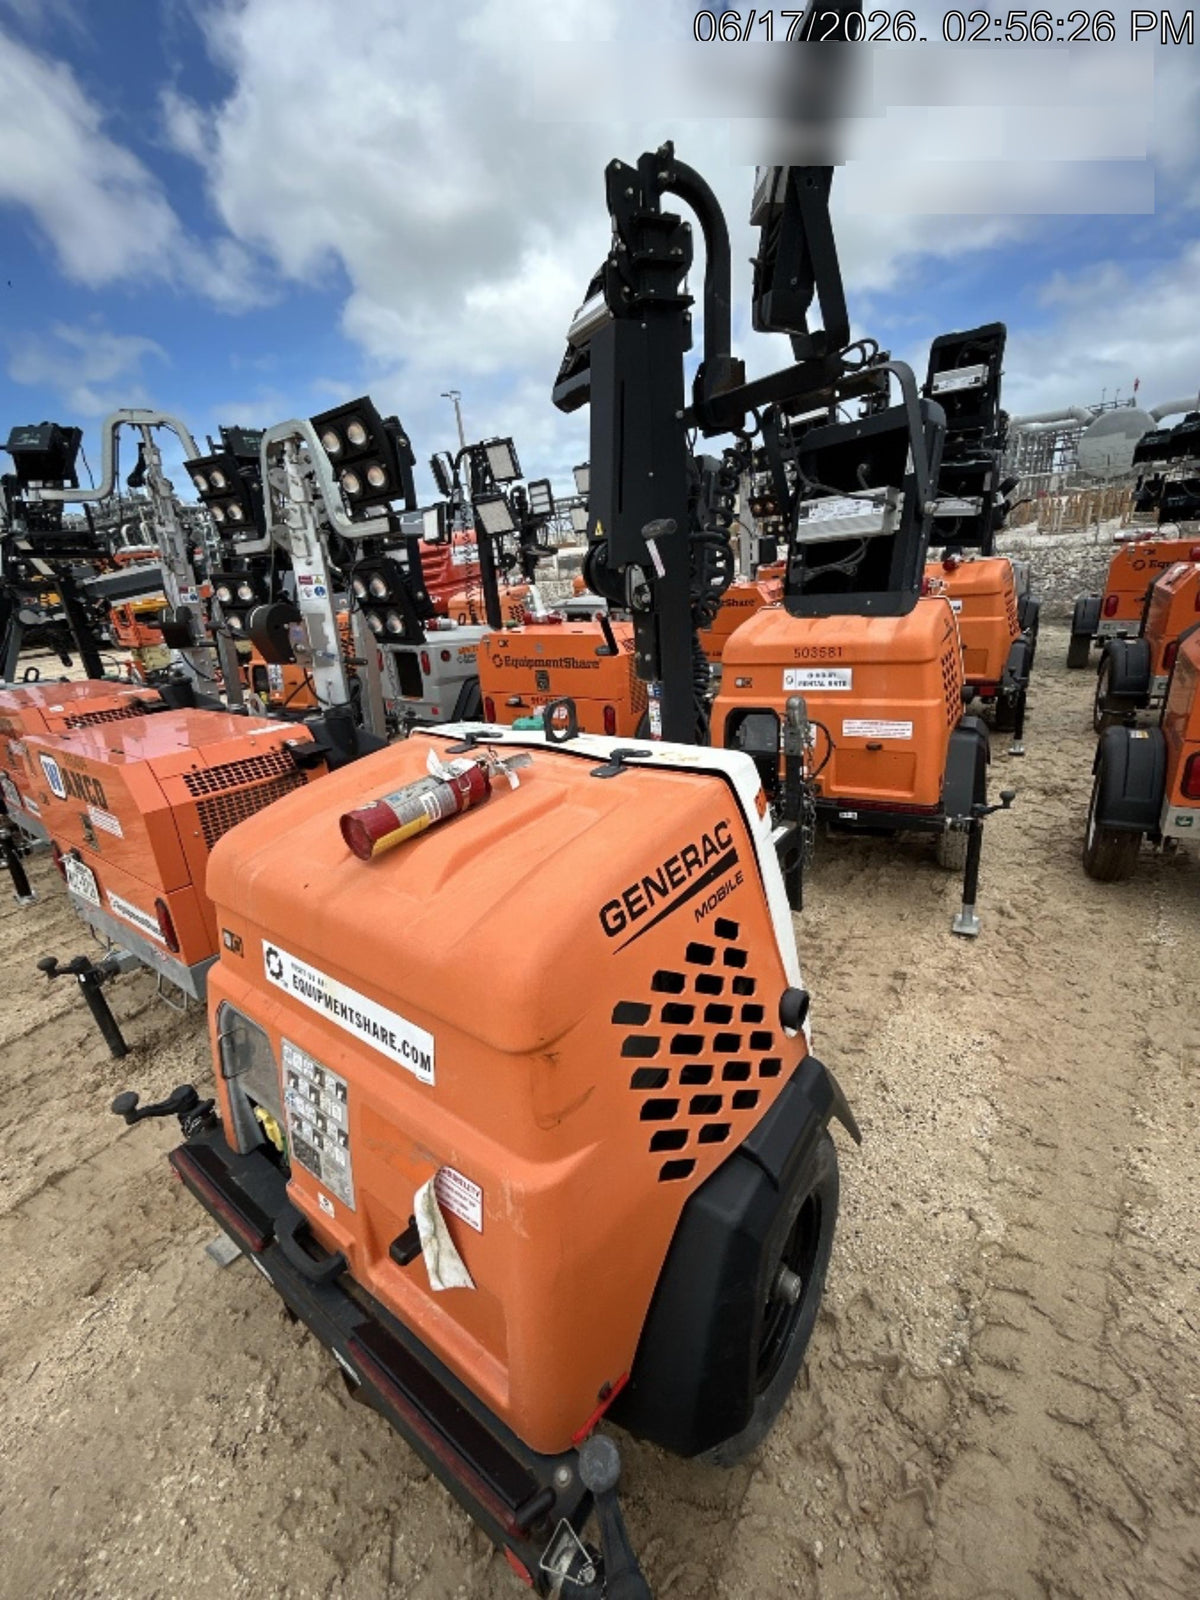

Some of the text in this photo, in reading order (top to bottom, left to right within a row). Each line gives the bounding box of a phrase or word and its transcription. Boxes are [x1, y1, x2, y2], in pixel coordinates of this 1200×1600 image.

[504, 655, 600, 670] EquipmentShare
[598, 820, 734, 938] GENERAC
[693, 869, 745, 924] MOBILE
[292, 973, 432, 1073] EQUIPMENTSHARE.COM
